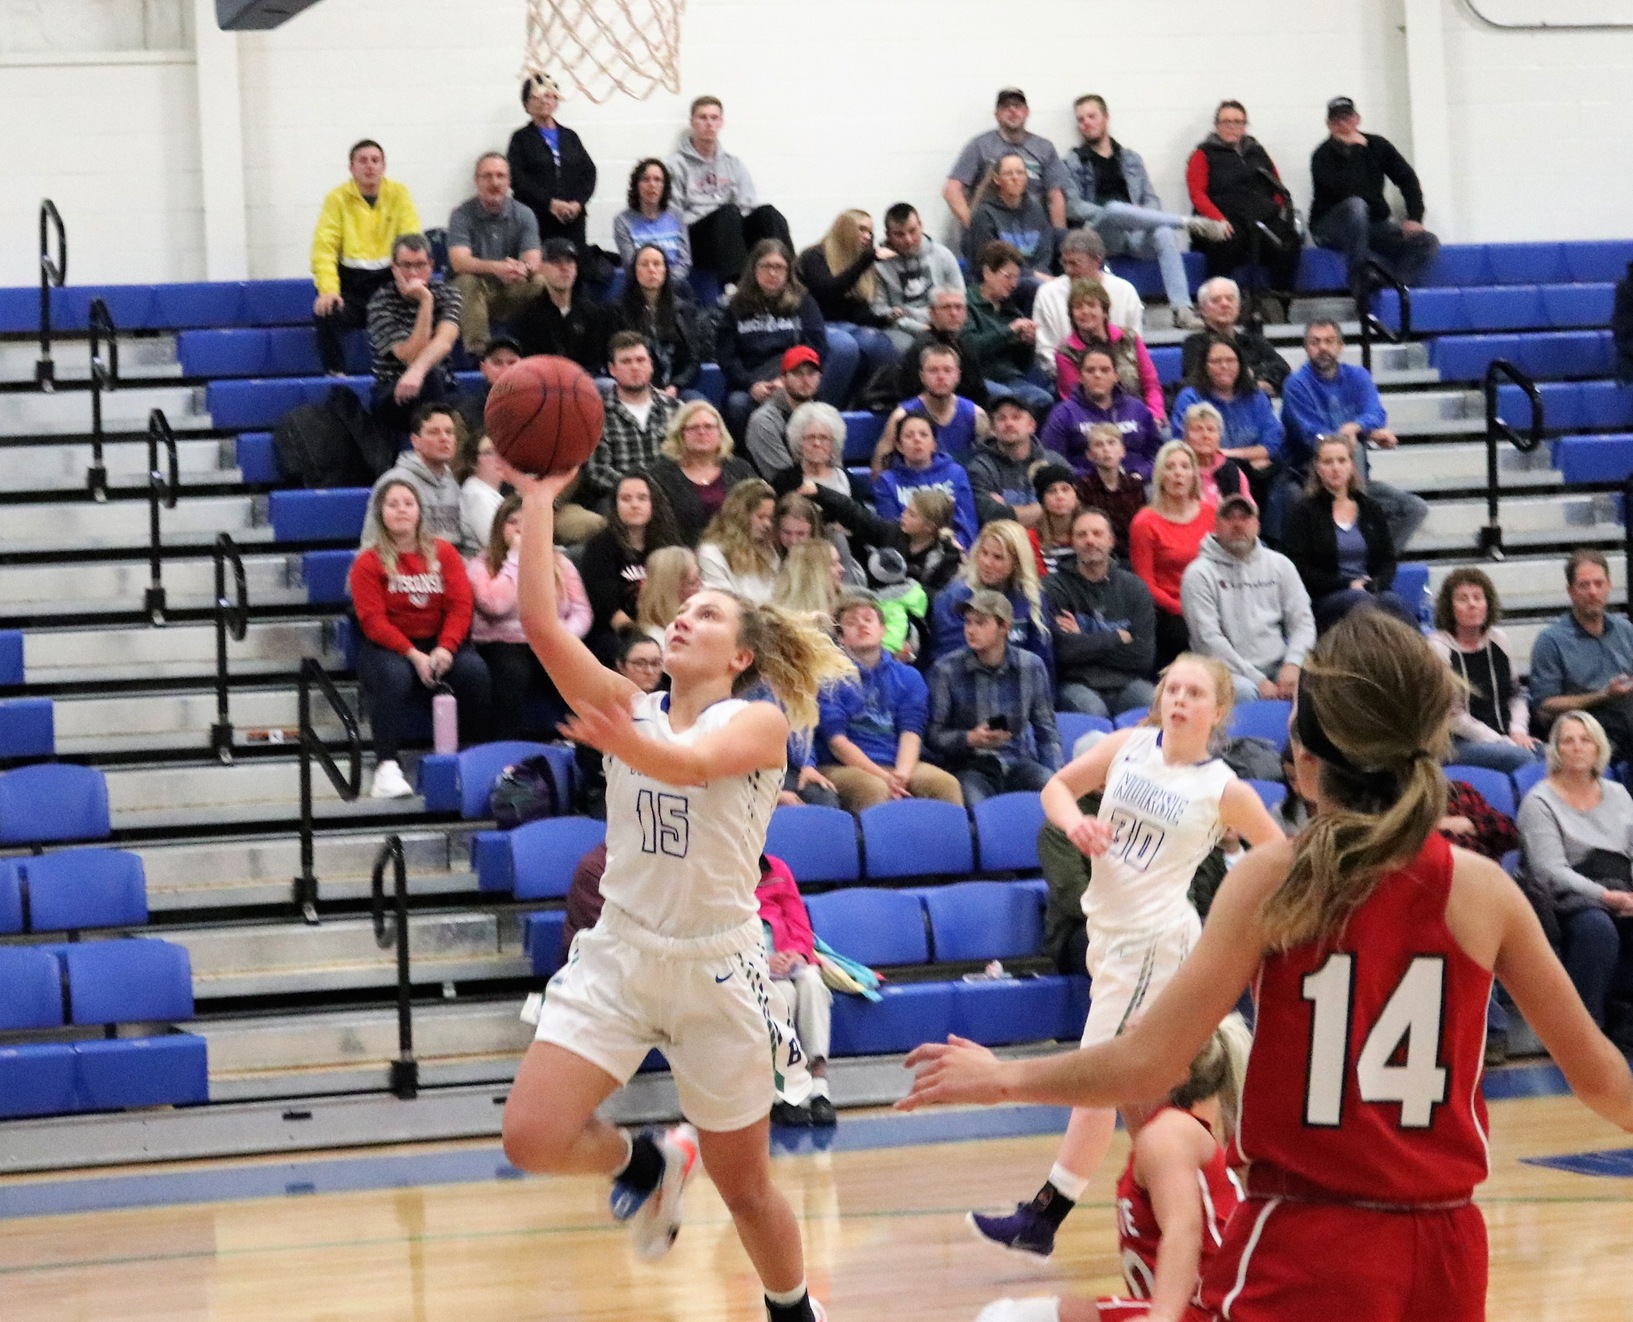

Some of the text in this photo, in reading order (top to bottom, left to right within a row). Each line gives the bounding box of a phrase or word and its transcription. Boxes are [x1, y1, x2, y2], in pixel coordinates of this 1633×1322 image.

[636, 788, 689, 859] 15
[1110, 807, 1165, 873] 30
[1302, 952, 1448, 1128] 14
